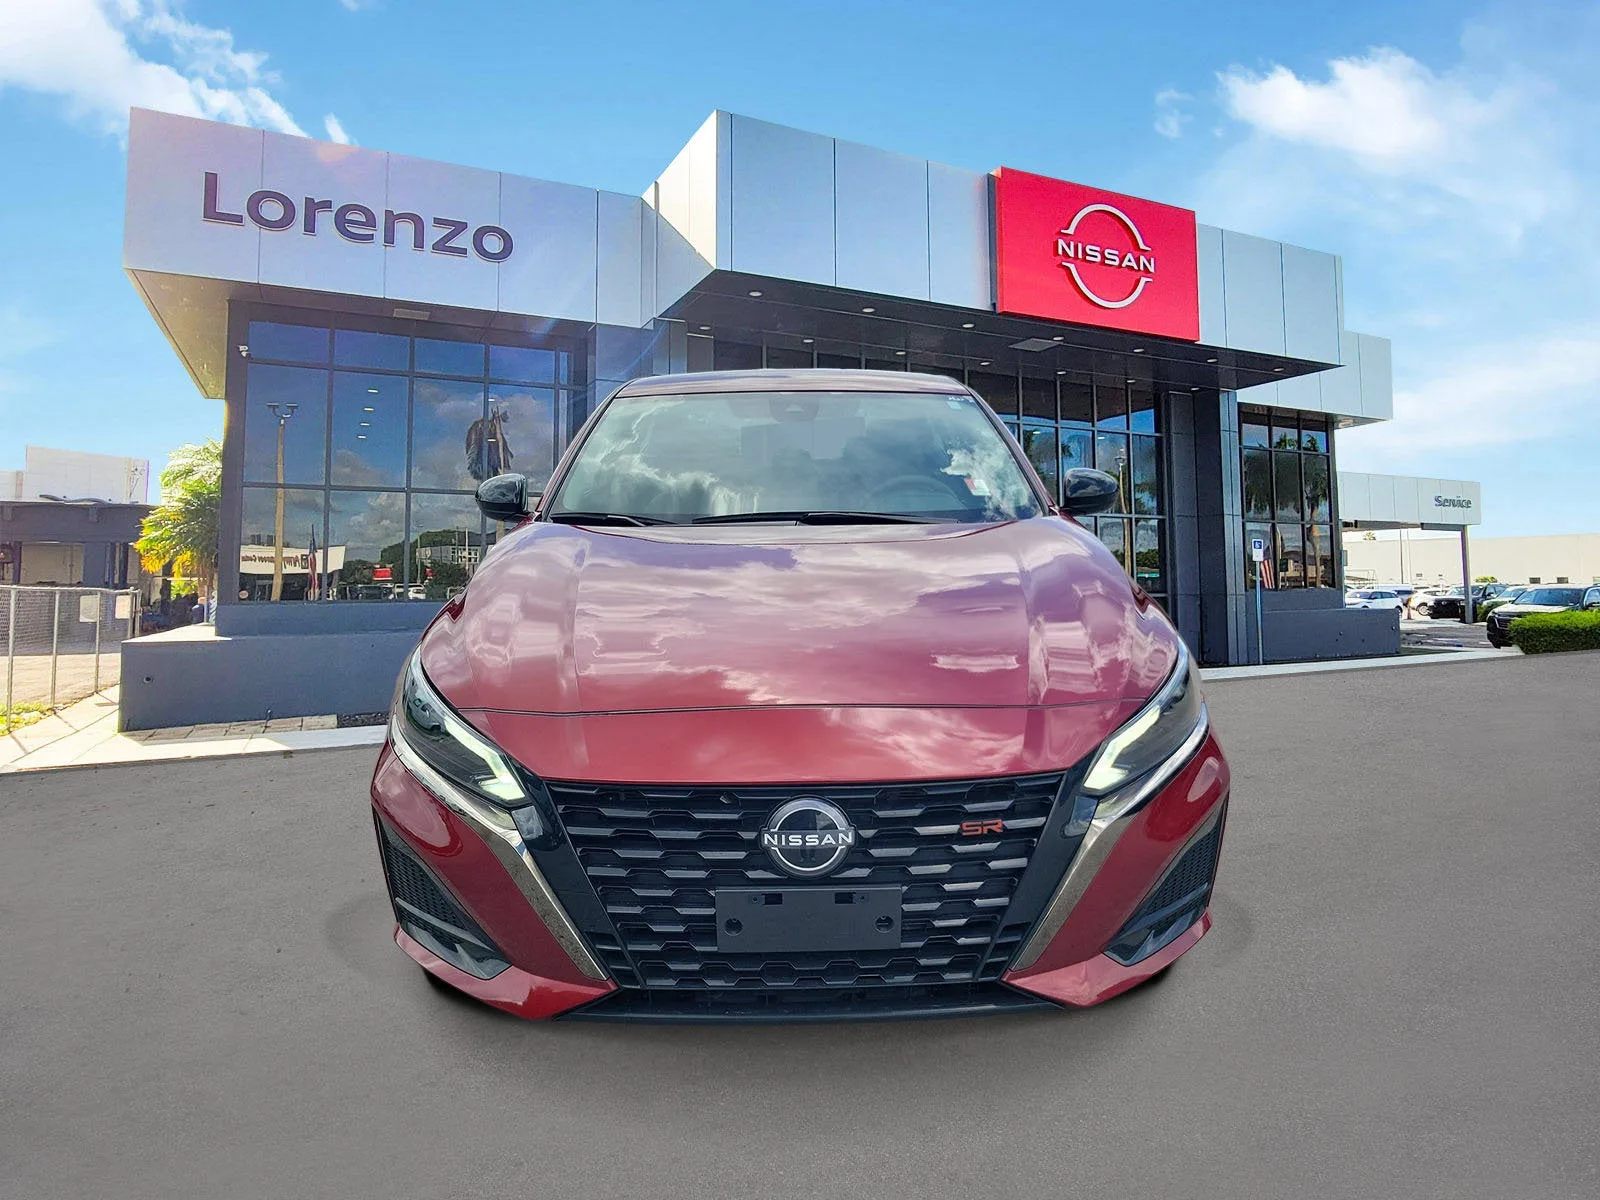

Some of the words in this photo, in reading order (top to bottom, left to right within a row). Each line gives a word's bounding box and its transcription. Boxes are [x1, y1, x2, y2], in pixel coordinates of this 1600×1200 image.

[203, 171, 514, 262] Lorenzo
[1057, 238, 1155, 273] NISSAN
[1434, 495, 1472, 508] Service
[961, 819, 1004, 836] SR
[764, 831, 852, 846] NISSAN
